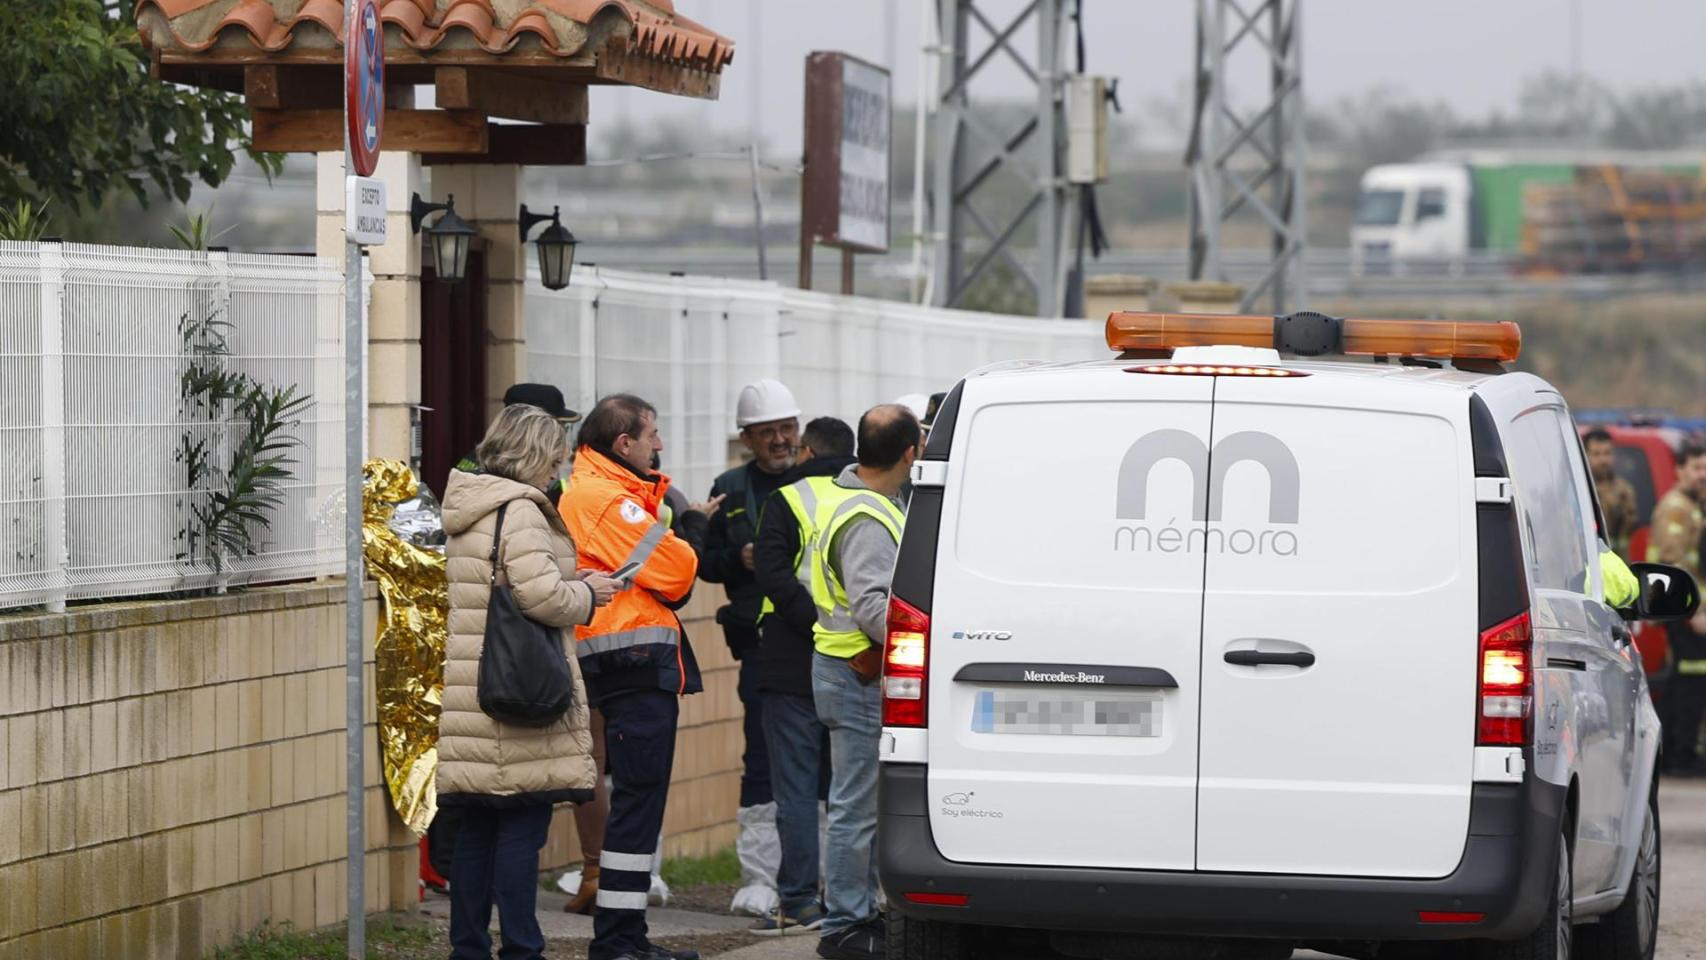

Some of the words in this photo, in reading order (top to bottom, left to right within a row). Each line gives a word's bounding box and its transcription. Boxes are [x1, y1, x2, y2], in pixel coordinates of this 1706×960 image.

[361, 187, 380, 205] EXCEPTO
[357, 215, 386, 234] AMBULANCIAS
[1114, 517, 1298, 556] mémora
[1024, 670, 1105, 684] Mercedes-Benz
[942, 807, 959, 818] Soy
